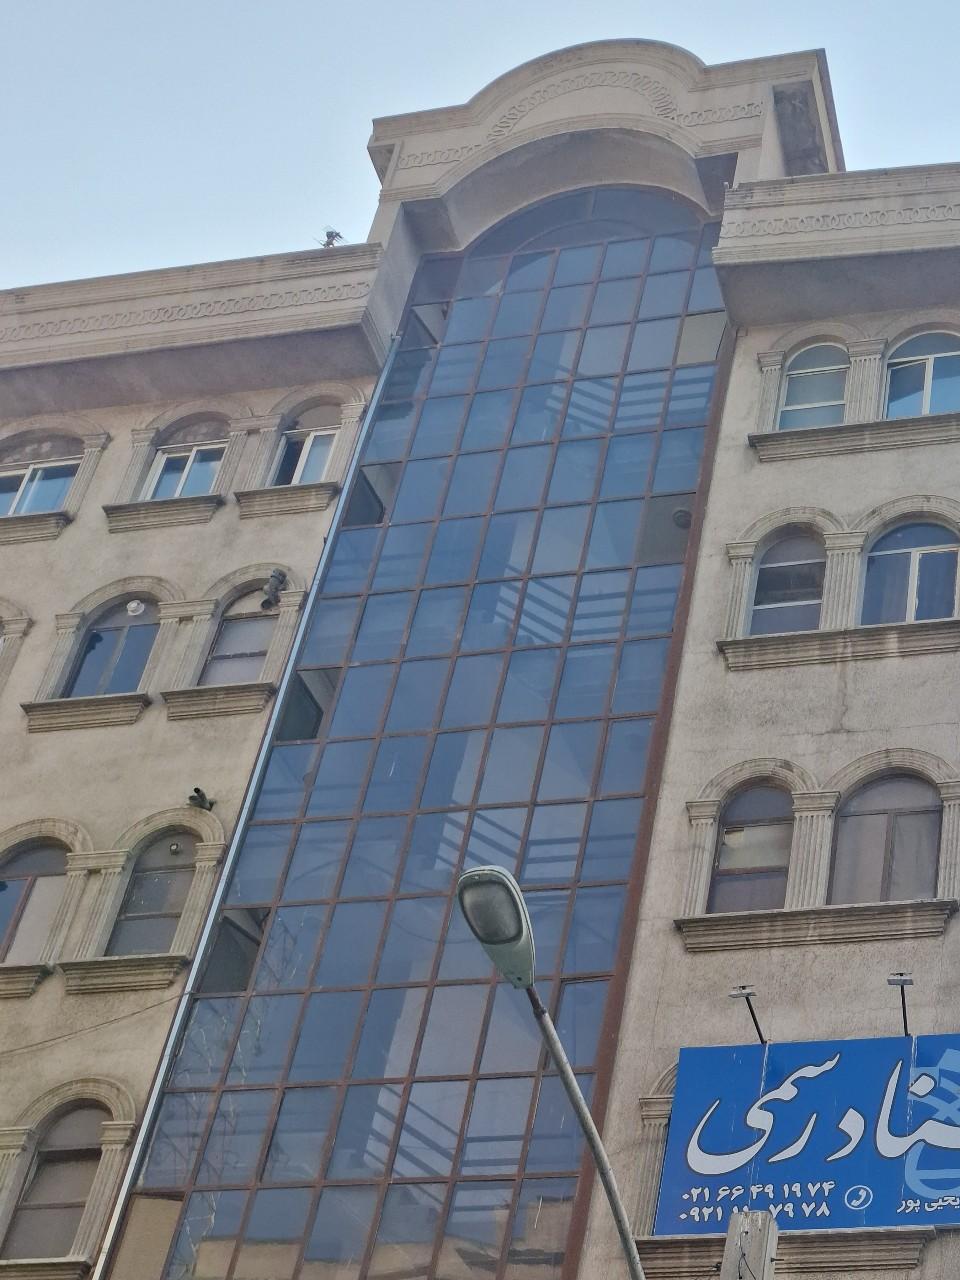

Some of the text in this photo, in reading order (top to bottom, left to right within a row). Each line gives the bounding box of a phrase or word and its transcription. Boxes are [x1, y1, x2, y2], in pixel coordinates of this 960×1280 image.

[687, 1052, 842, 1175] رسمی
[681, 1180, 836, 1202] ۰۲۱ ۶۶ ۴۹ ۱۹ ۷۴
[679, 1206, 723, 1222] ۰۹۲۱
[801, 1201, 831, 1217] ۷۸
[896, 1197, 921, 1213] پور
[924, 1194, 960, 1212] یحیی
